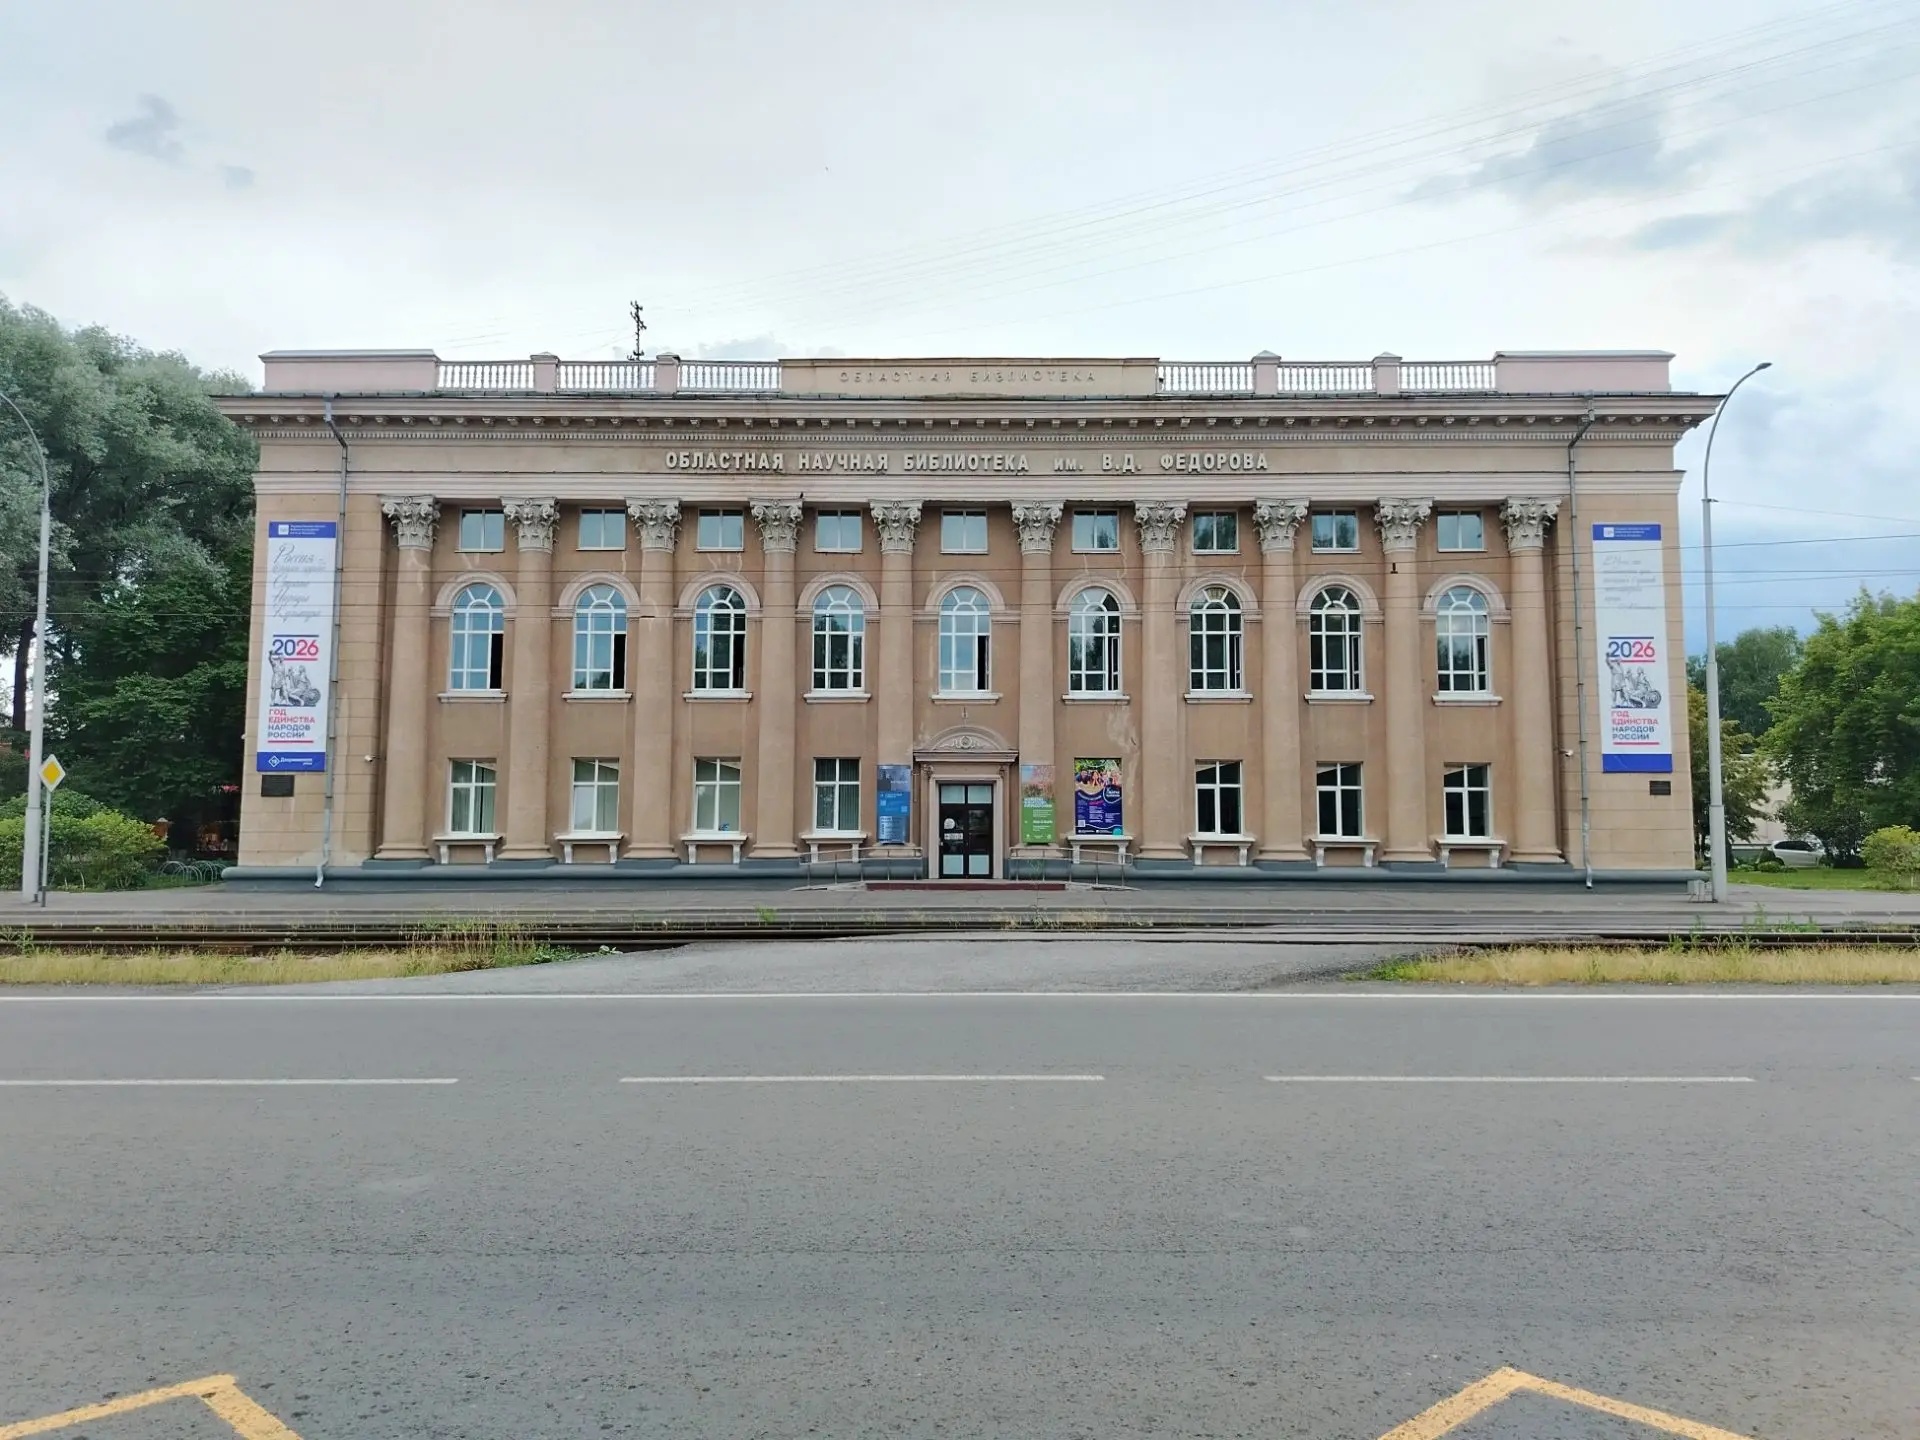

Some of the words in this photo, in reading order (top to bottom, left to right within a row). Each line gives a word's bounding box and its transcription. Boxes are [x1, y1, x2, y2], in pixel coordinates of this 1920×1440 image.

[665, 452, 784, 470] ОБЛАСТНАЯ
[798, 453, 889, 471] НАУЧНАЯ
[903, 453, 1030, 472] БИБЛИОТЕКА
[1160, 453, 1268, 473] ФЕДОРОВА
[272, 639, 319, 656] 2026
[1608, 641, 1656, 658] 2026
[269, 709, 287, 717] ГОД
[1611, 710, 1630, 718] ГОД
[268, 716, 316, 724] ЕДИНСТВА
[1611, 718, 1659, 726] ЕДИНСТВА
[268, 724, 311, 732] НАРОДОВ
[1612, 725, 1655, 733] НАРОДОВ
[267, 731, 305, 739] РОССИИ
[1612, 733, 1650, 741] РОССИИ
